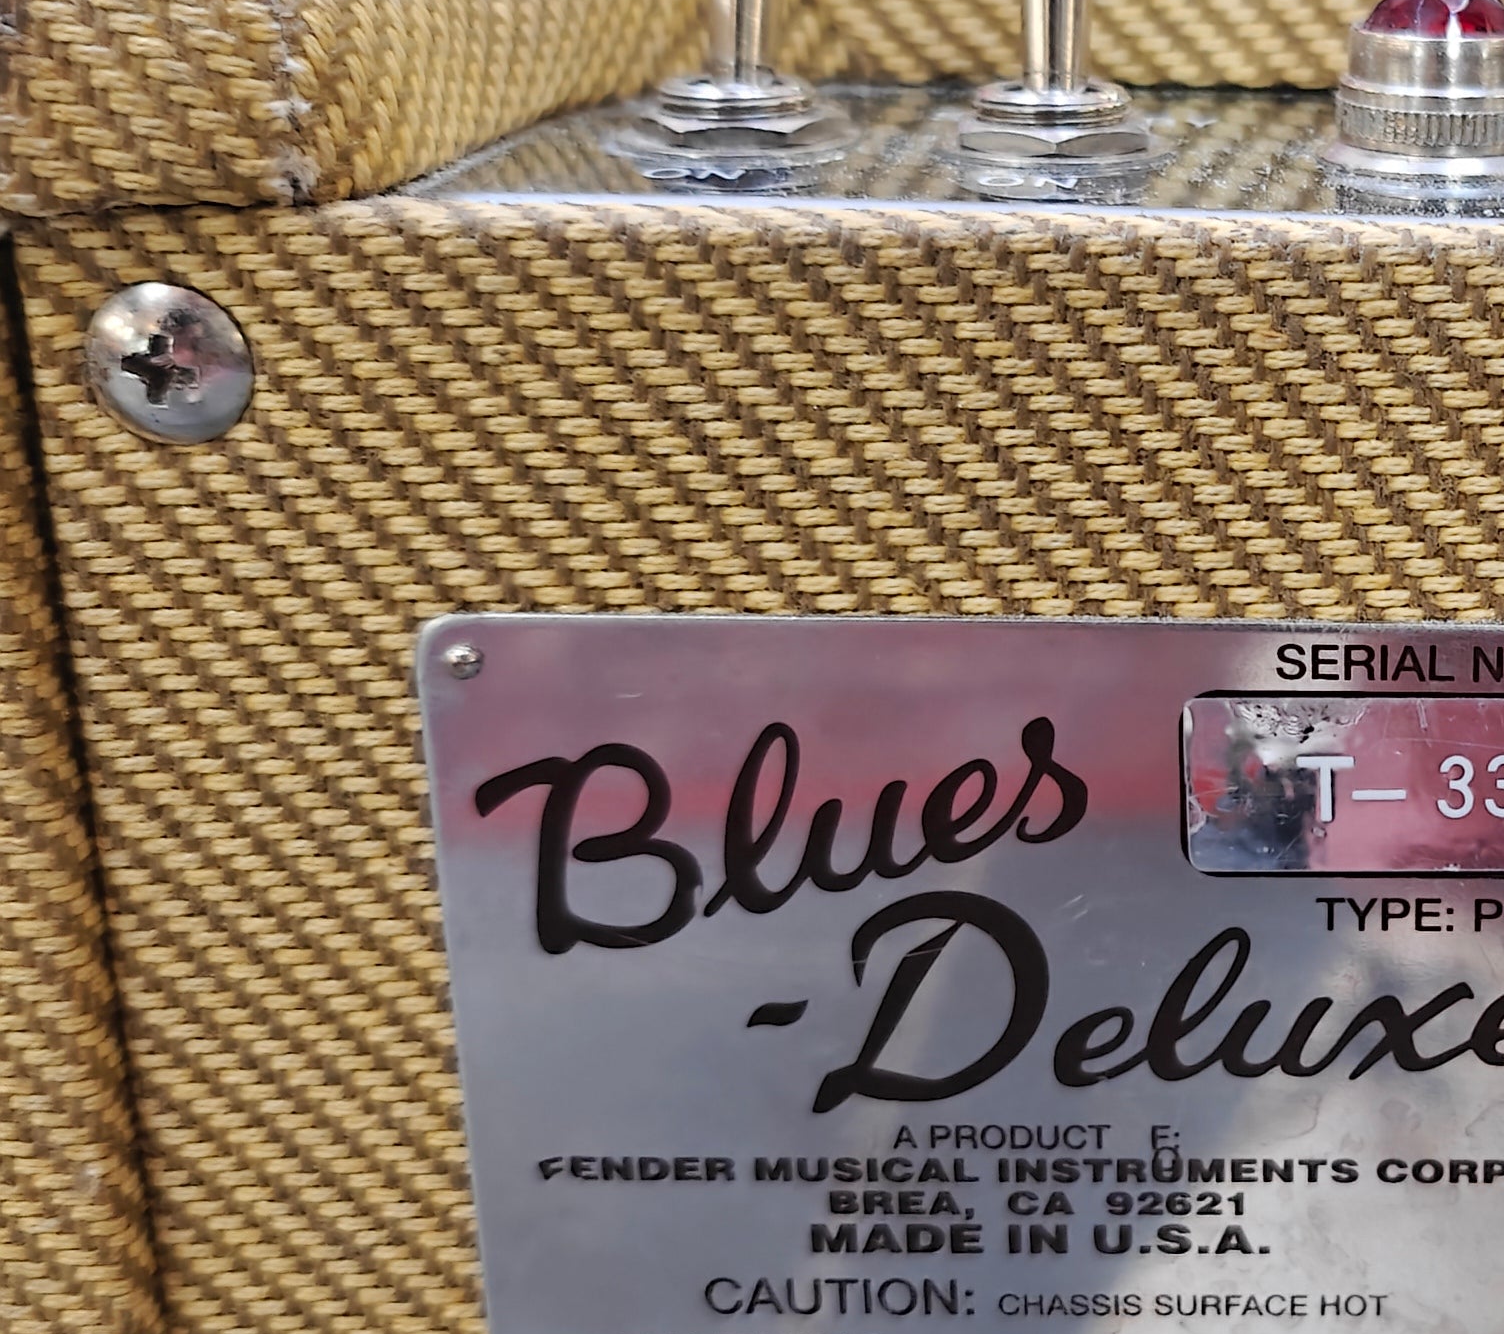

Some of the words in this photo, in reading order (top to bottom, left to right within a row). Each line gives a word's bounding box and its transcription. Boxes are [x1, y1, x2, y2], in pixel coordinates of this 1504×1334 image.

[977, 174, 1079, 189] ON
[1276, 643, 1454, 682] SERIAL
[475, 716, 1088, 954] Blues
[1316, 897, 1454, 933] TYPE:
[893, 1125, 918, 1149] A
[931, 1124, 1111, 1150] PRODUCT
[538, 1156, 736, 1181] FENDER
[754, 1157, 979, 1183] MUSICAL
[998, 1158, 1359, 1184] INSTRUMENTS
[828, 1191, 976, 1220] BREA,
[1007, 1192, 1075, 1216] CA
[1105, 1192, 1246, 1216] 92621
[810, 1223, 985, 1254] MADE
[1007, 1224, 1069, 1255] IN
[1093, 1224, 1271, 1255] U.S.A.
[704, 1278, 975, 1316] CAUTION:
[998, 1294, 1142, 1316] CHASSIS
[1154, 1294, 1308, 1317] SURFACE
[1320, 1294, 1388, 1317] HOT
